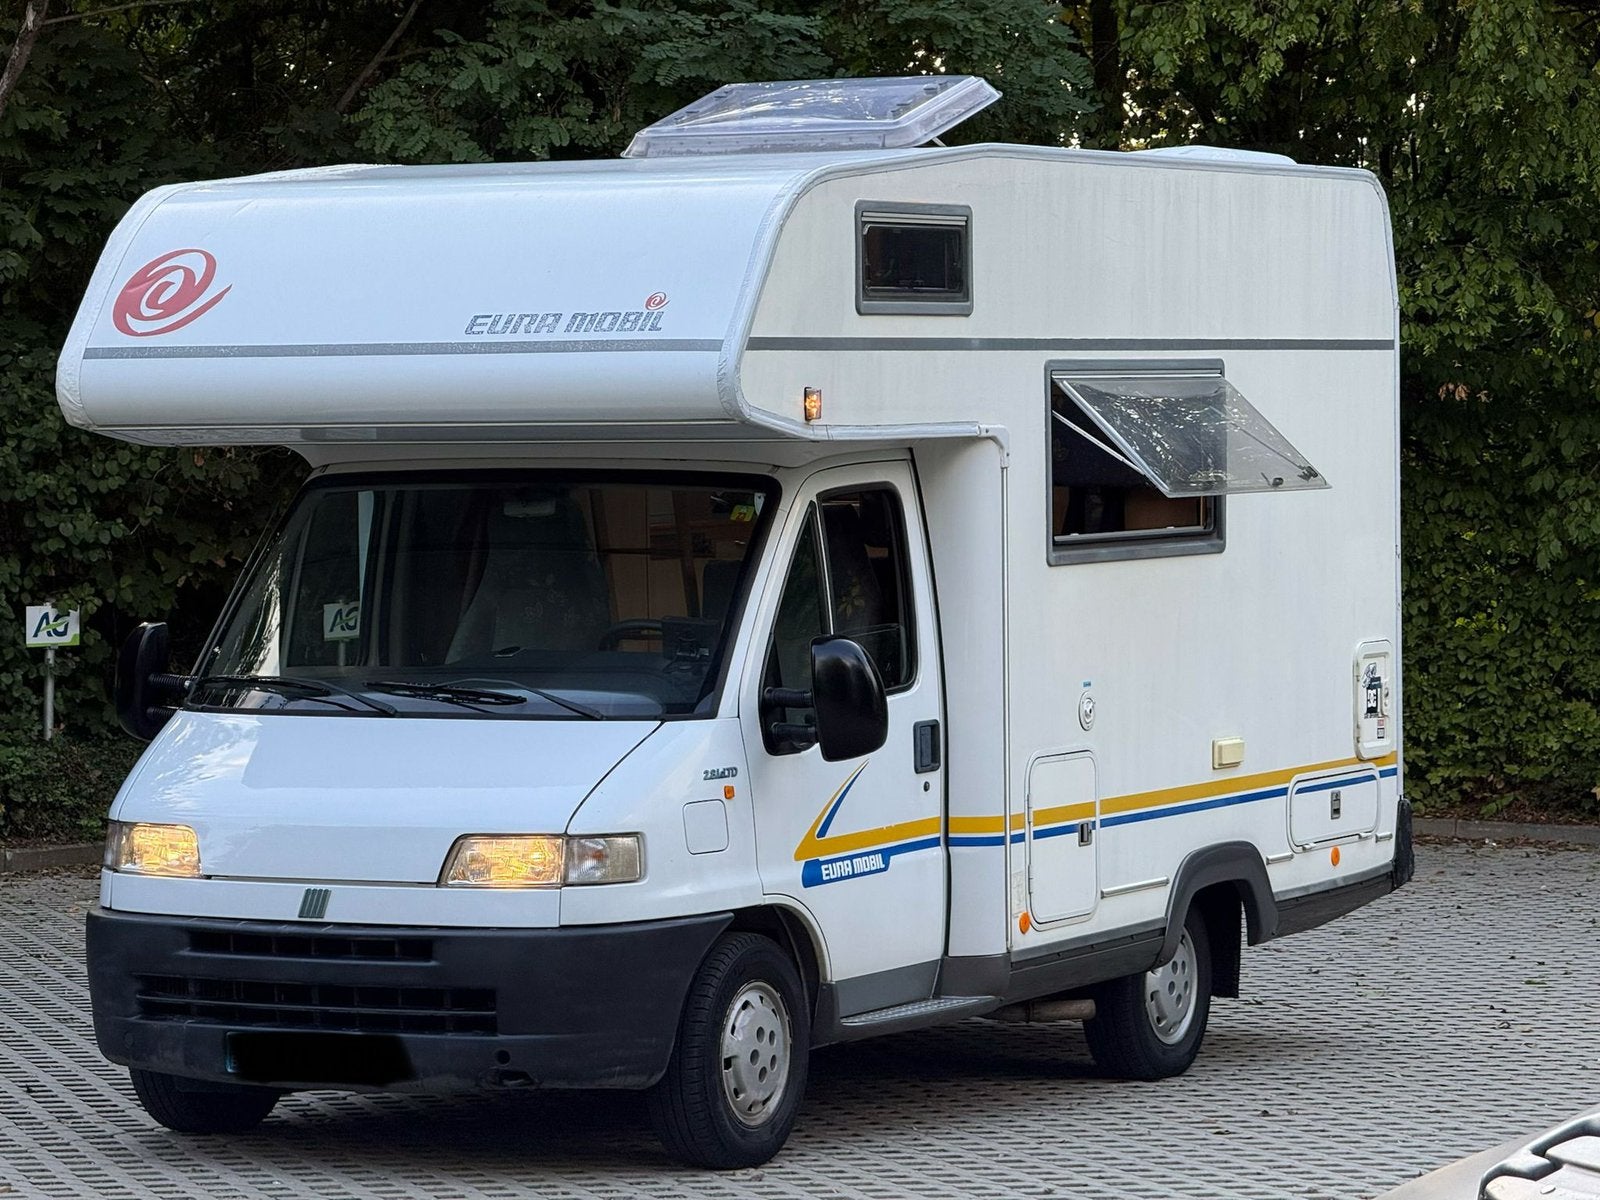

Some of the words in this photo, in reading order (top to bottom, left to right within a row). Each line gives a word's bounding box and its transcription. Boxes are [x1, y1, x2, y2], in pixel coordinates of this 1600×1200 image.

[465, 313, 563, 335] EURA
[564, 311, 665, 333] MOBIL
[32, 612, 70, 638] AG
[821, 862, 853, 881] EURA
[853, 853, 885, 873] MOBIL
